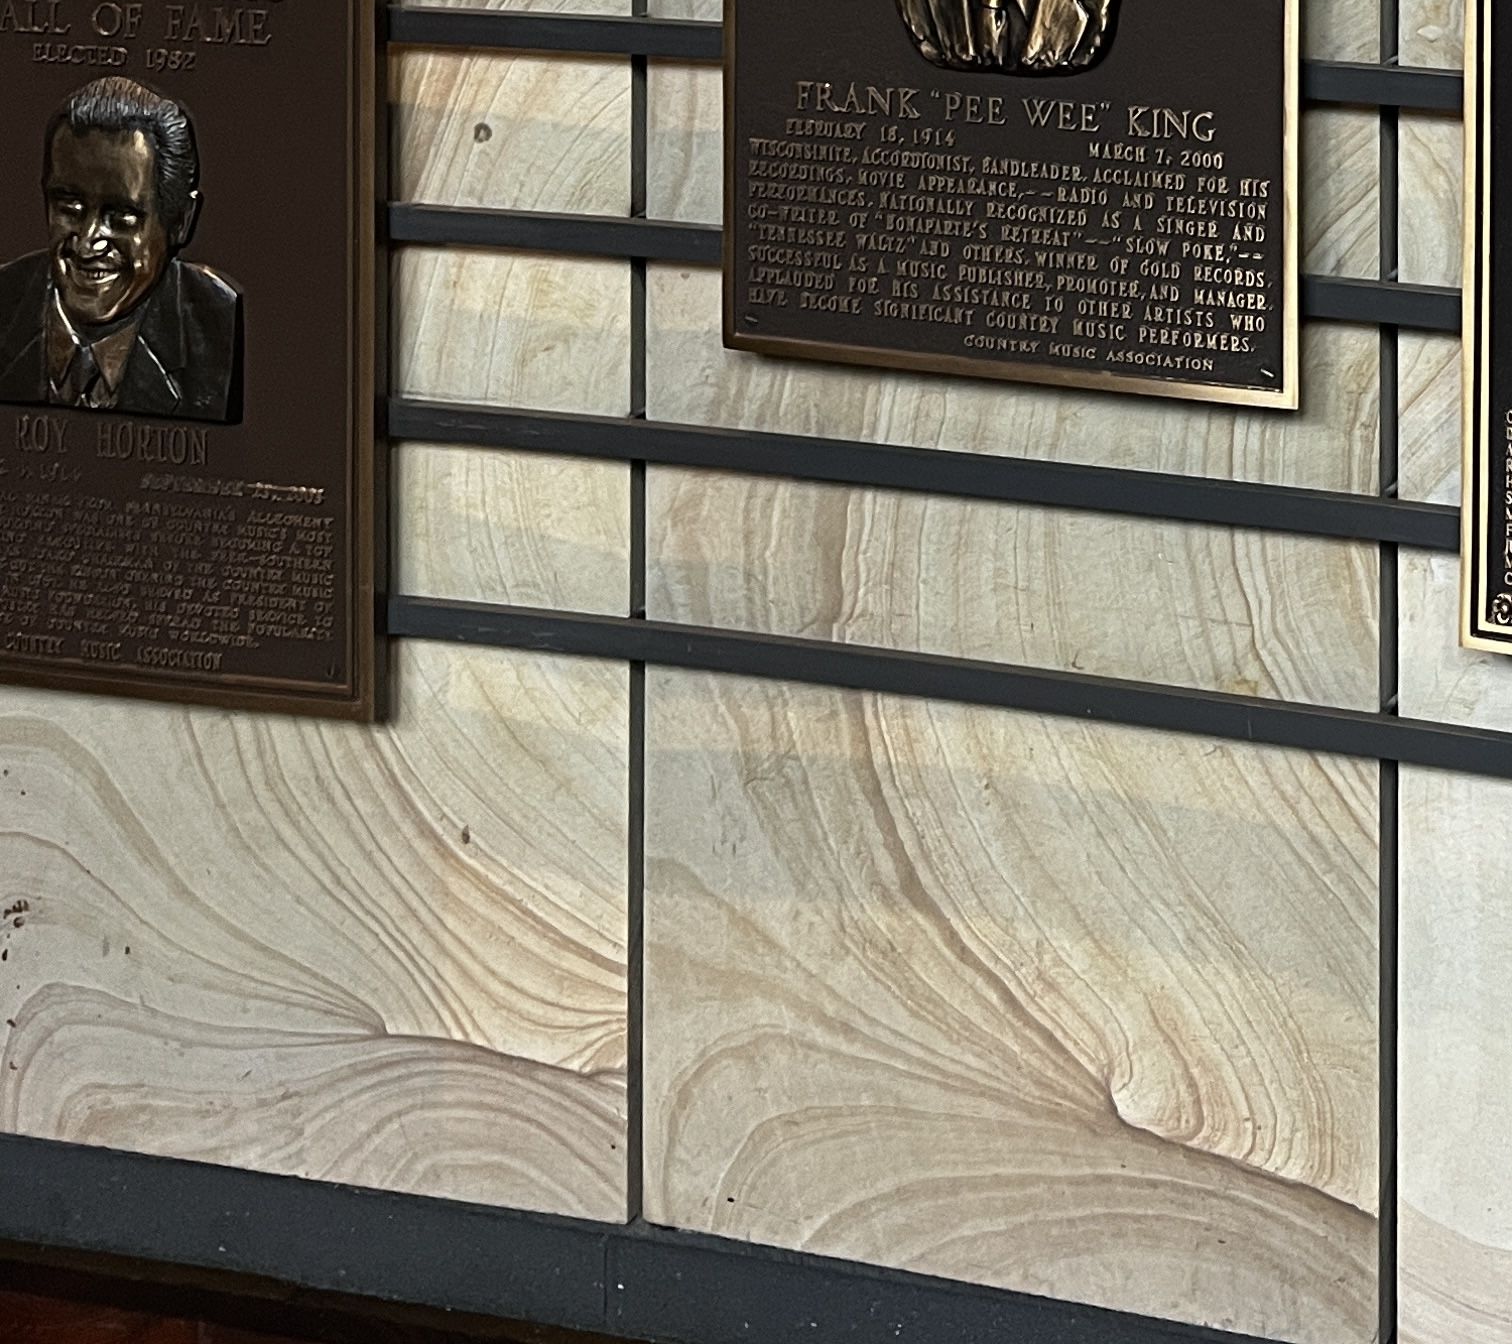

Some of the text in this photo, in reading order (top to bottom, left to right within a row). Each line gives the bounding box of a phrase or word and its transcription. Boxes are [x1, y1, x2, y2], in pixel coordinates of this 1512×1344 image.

[91, 1, 144, 39] OF
[164, 5, 273, 47] FAME
[32, 43, 197, 72] ELECTED 1982
[796, 80, 921, 119] FRANK
[1126, 105, 1217, 142] KING
[785, 118, 867, 140] FEBRUARY
[912, 127, 956, 148] 1914
[1088, 142, 1224, 171] MARCH 7, 2000
[962, 333, 1216, 373] COUNTRY MUSIC ASSOCIATION
[15, 415, 210, 466] ROY HORTON
